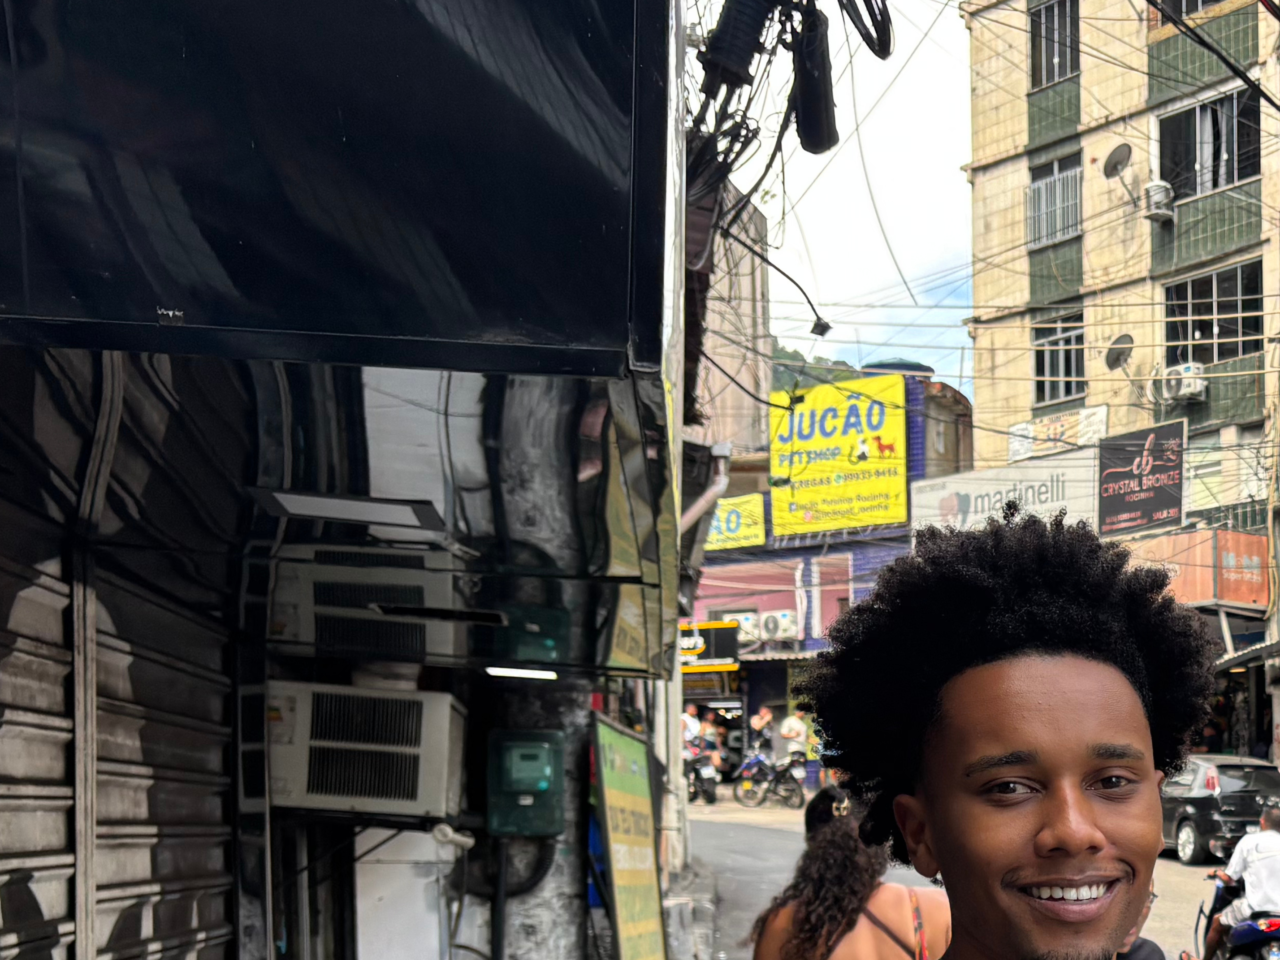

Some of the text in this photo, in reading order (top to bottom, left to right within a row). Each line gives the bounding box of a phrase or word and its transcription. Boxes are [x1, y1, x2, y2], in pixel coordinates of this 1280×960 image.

[778, 393, 886, 444] JUCÃO
[1101, 470, 1180, 497] CRYSTAL BRONZE
